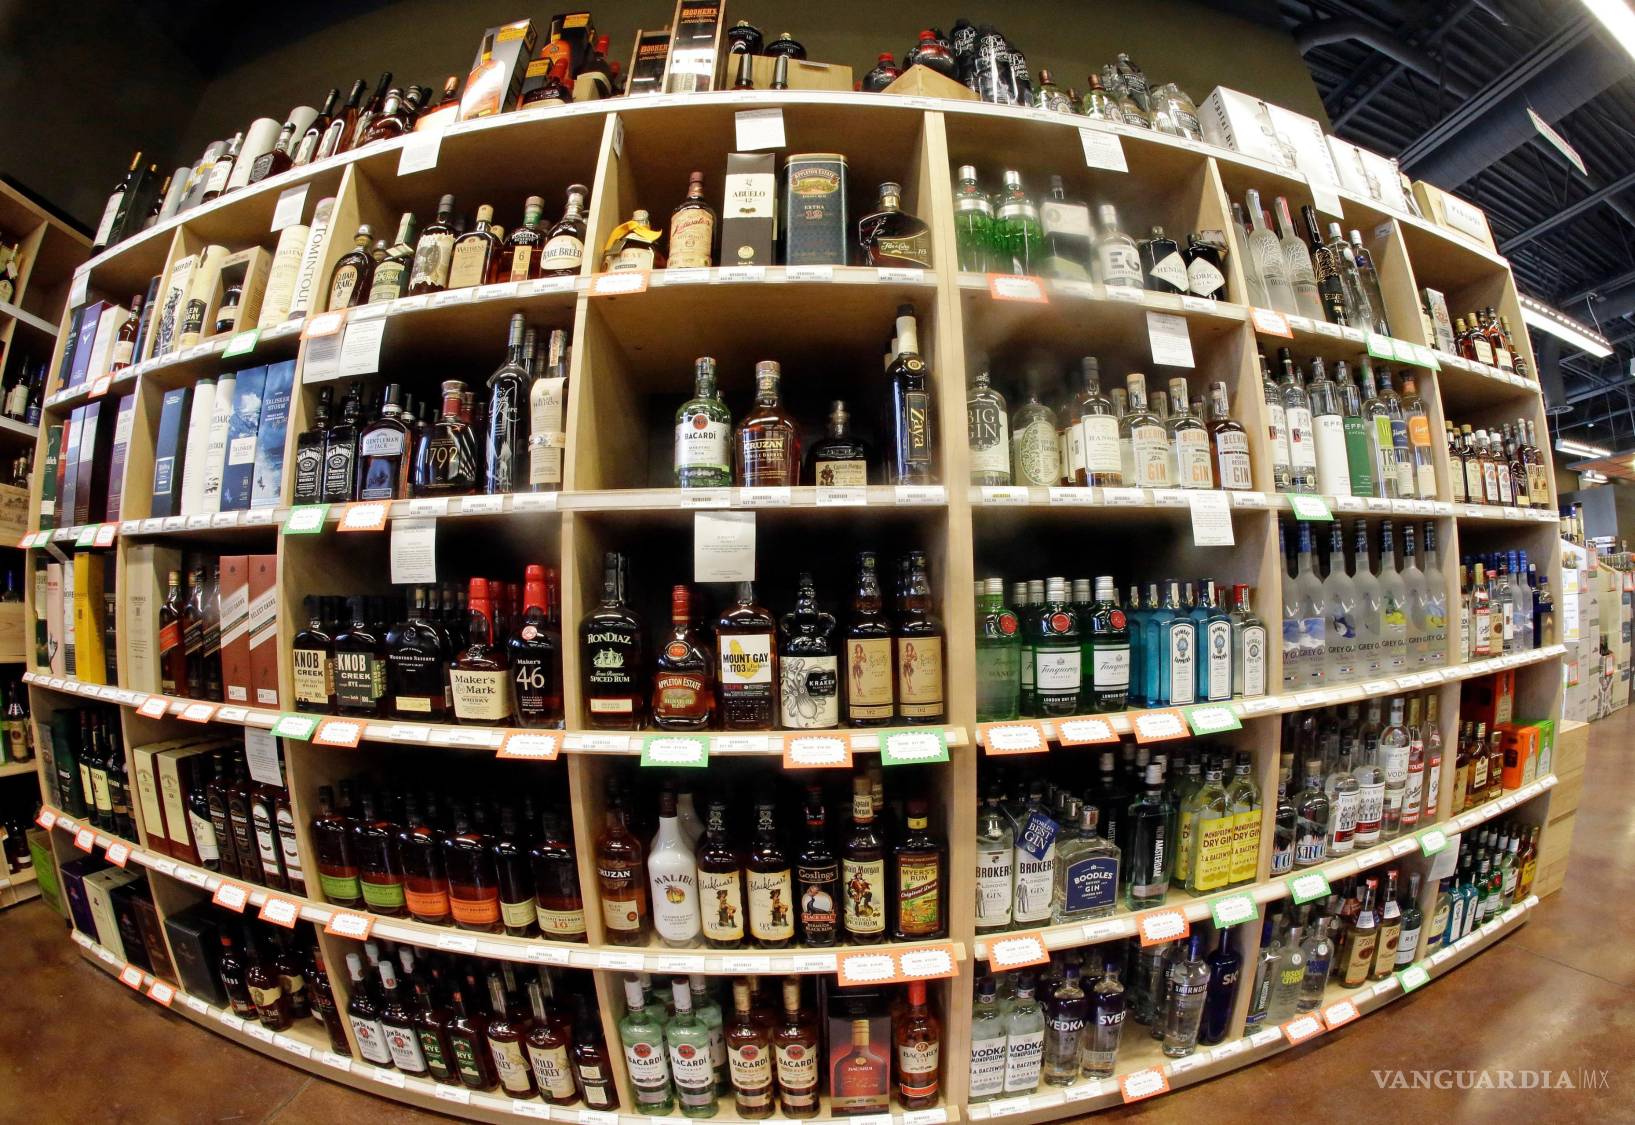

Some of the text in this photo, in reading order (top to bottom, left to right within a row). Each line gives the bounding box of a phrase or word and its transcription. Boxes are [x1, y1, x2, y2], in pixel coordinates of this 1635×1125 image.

[733, 190, 766, 198] ABUELO
[519, 251, 525, 261] 6
[297, 223, 328, 307] TOMINTOUL
[968, 409, 996, 423] BIG
[910, 407, 925, 449] Zaya
[365, 437, 400, 447] GENTLEMAN
[425, 446, 457, 470] 1792
[1147, 463, 1167, 480] GIN
[1192, 464, 1209, 481] GIN
[1233, 466, 1250, 483] GIN
[294, 651, 319, 668] KNOB
[338, 653, 366, 671] KNOB
[722, 653, 769, 664] MOUNT GAY
[297, 669, 324, 677] CREEK
[729, 664, 746, 673] 1703
[341, 672, 371, 680] CREEK
[455, 675, 496, 685] Maker's
[515, 665, 545, 691] 46
[590, 675, 631, 684] SPICED RUM
[466, 685, 495, 695] Mark
[658, 678, 702, 691] APPLETON ESTATE
[1028, 822, 1053, 841] BEST
[1233, 831, 1249, 841] DRY
[1023, 831, 1049, 851] GIN
[1203, 838, 1220, 848] DRY
[798, 868, 835, 880] Goslings
[857, 864, 880, 874] Morgan
[654, 873, 696, 888] MALIBU
[1074, 871, 1114, 885] BOODLES
[1030, 886, 1045, 894] GIN
[1085, 885, 1100, 893] GIN
[1175, 984, 1208, 994] SMIRNOFF
[1099, 1011, 1126, 1025] SVED
[424, 1044, 441, 1053] RYE
[971, 1046, 1006, 1058] VODKA
[1009, 1040, 1044, 1052] VODKA
[456, 1050, 473, 1060] RYE
[533, 1055, 554, 1068] WILD
